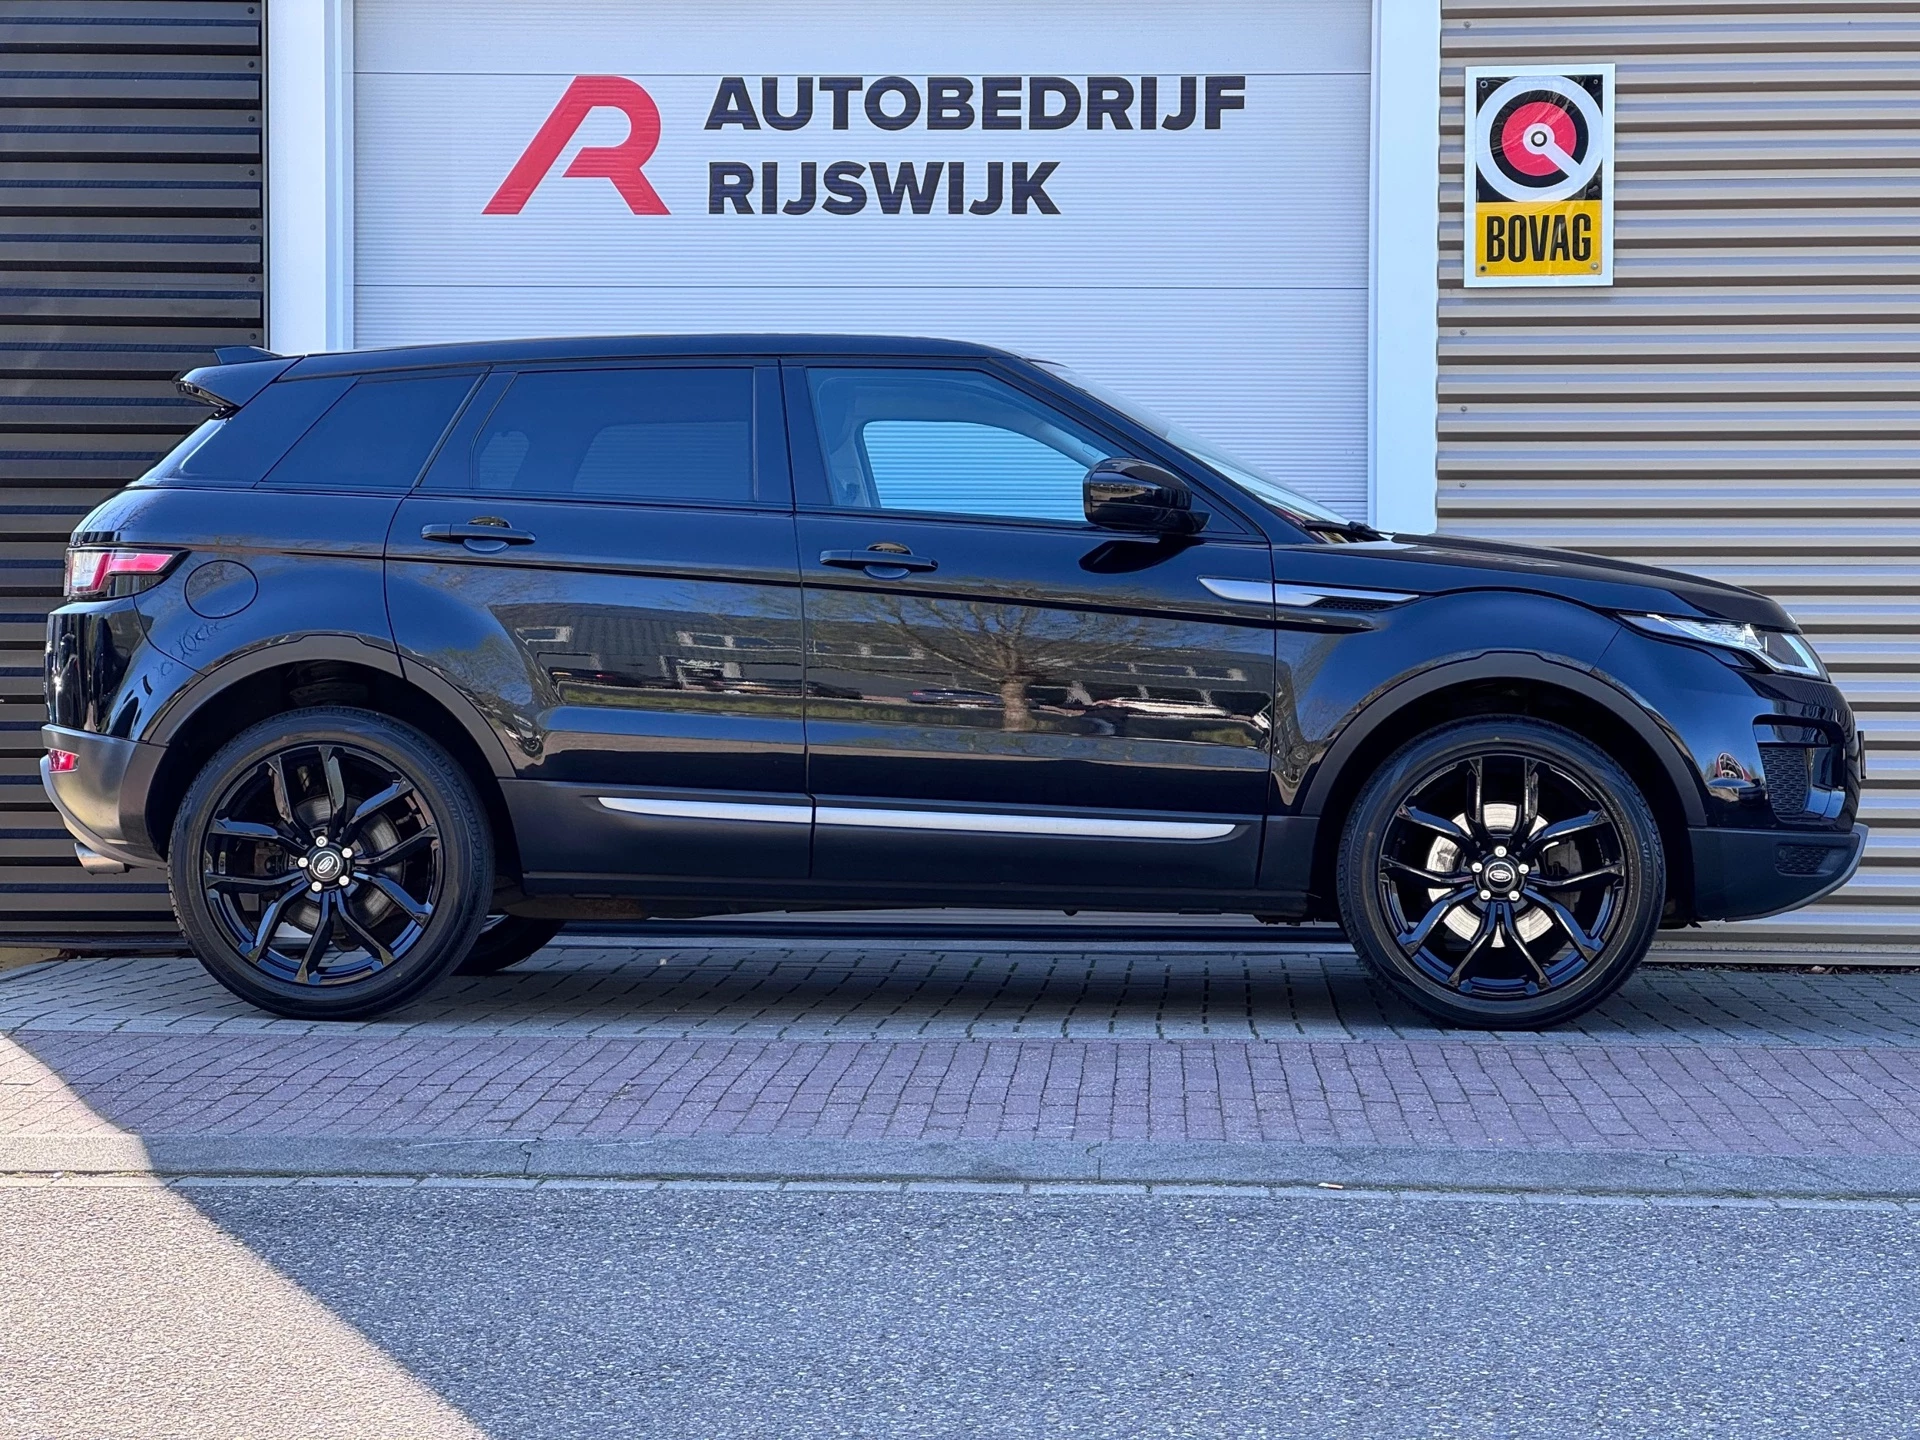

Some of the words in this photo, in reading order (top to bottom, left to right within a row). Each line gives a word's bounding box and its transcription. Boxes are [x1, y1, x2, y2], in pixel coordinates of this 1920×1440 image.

[704, 76, 1246, 131] AUTOBEDRIJF
[709, 161, 1062, 216] RIJSWIJK
[1486, 213, 1592, 263] BOVAG
